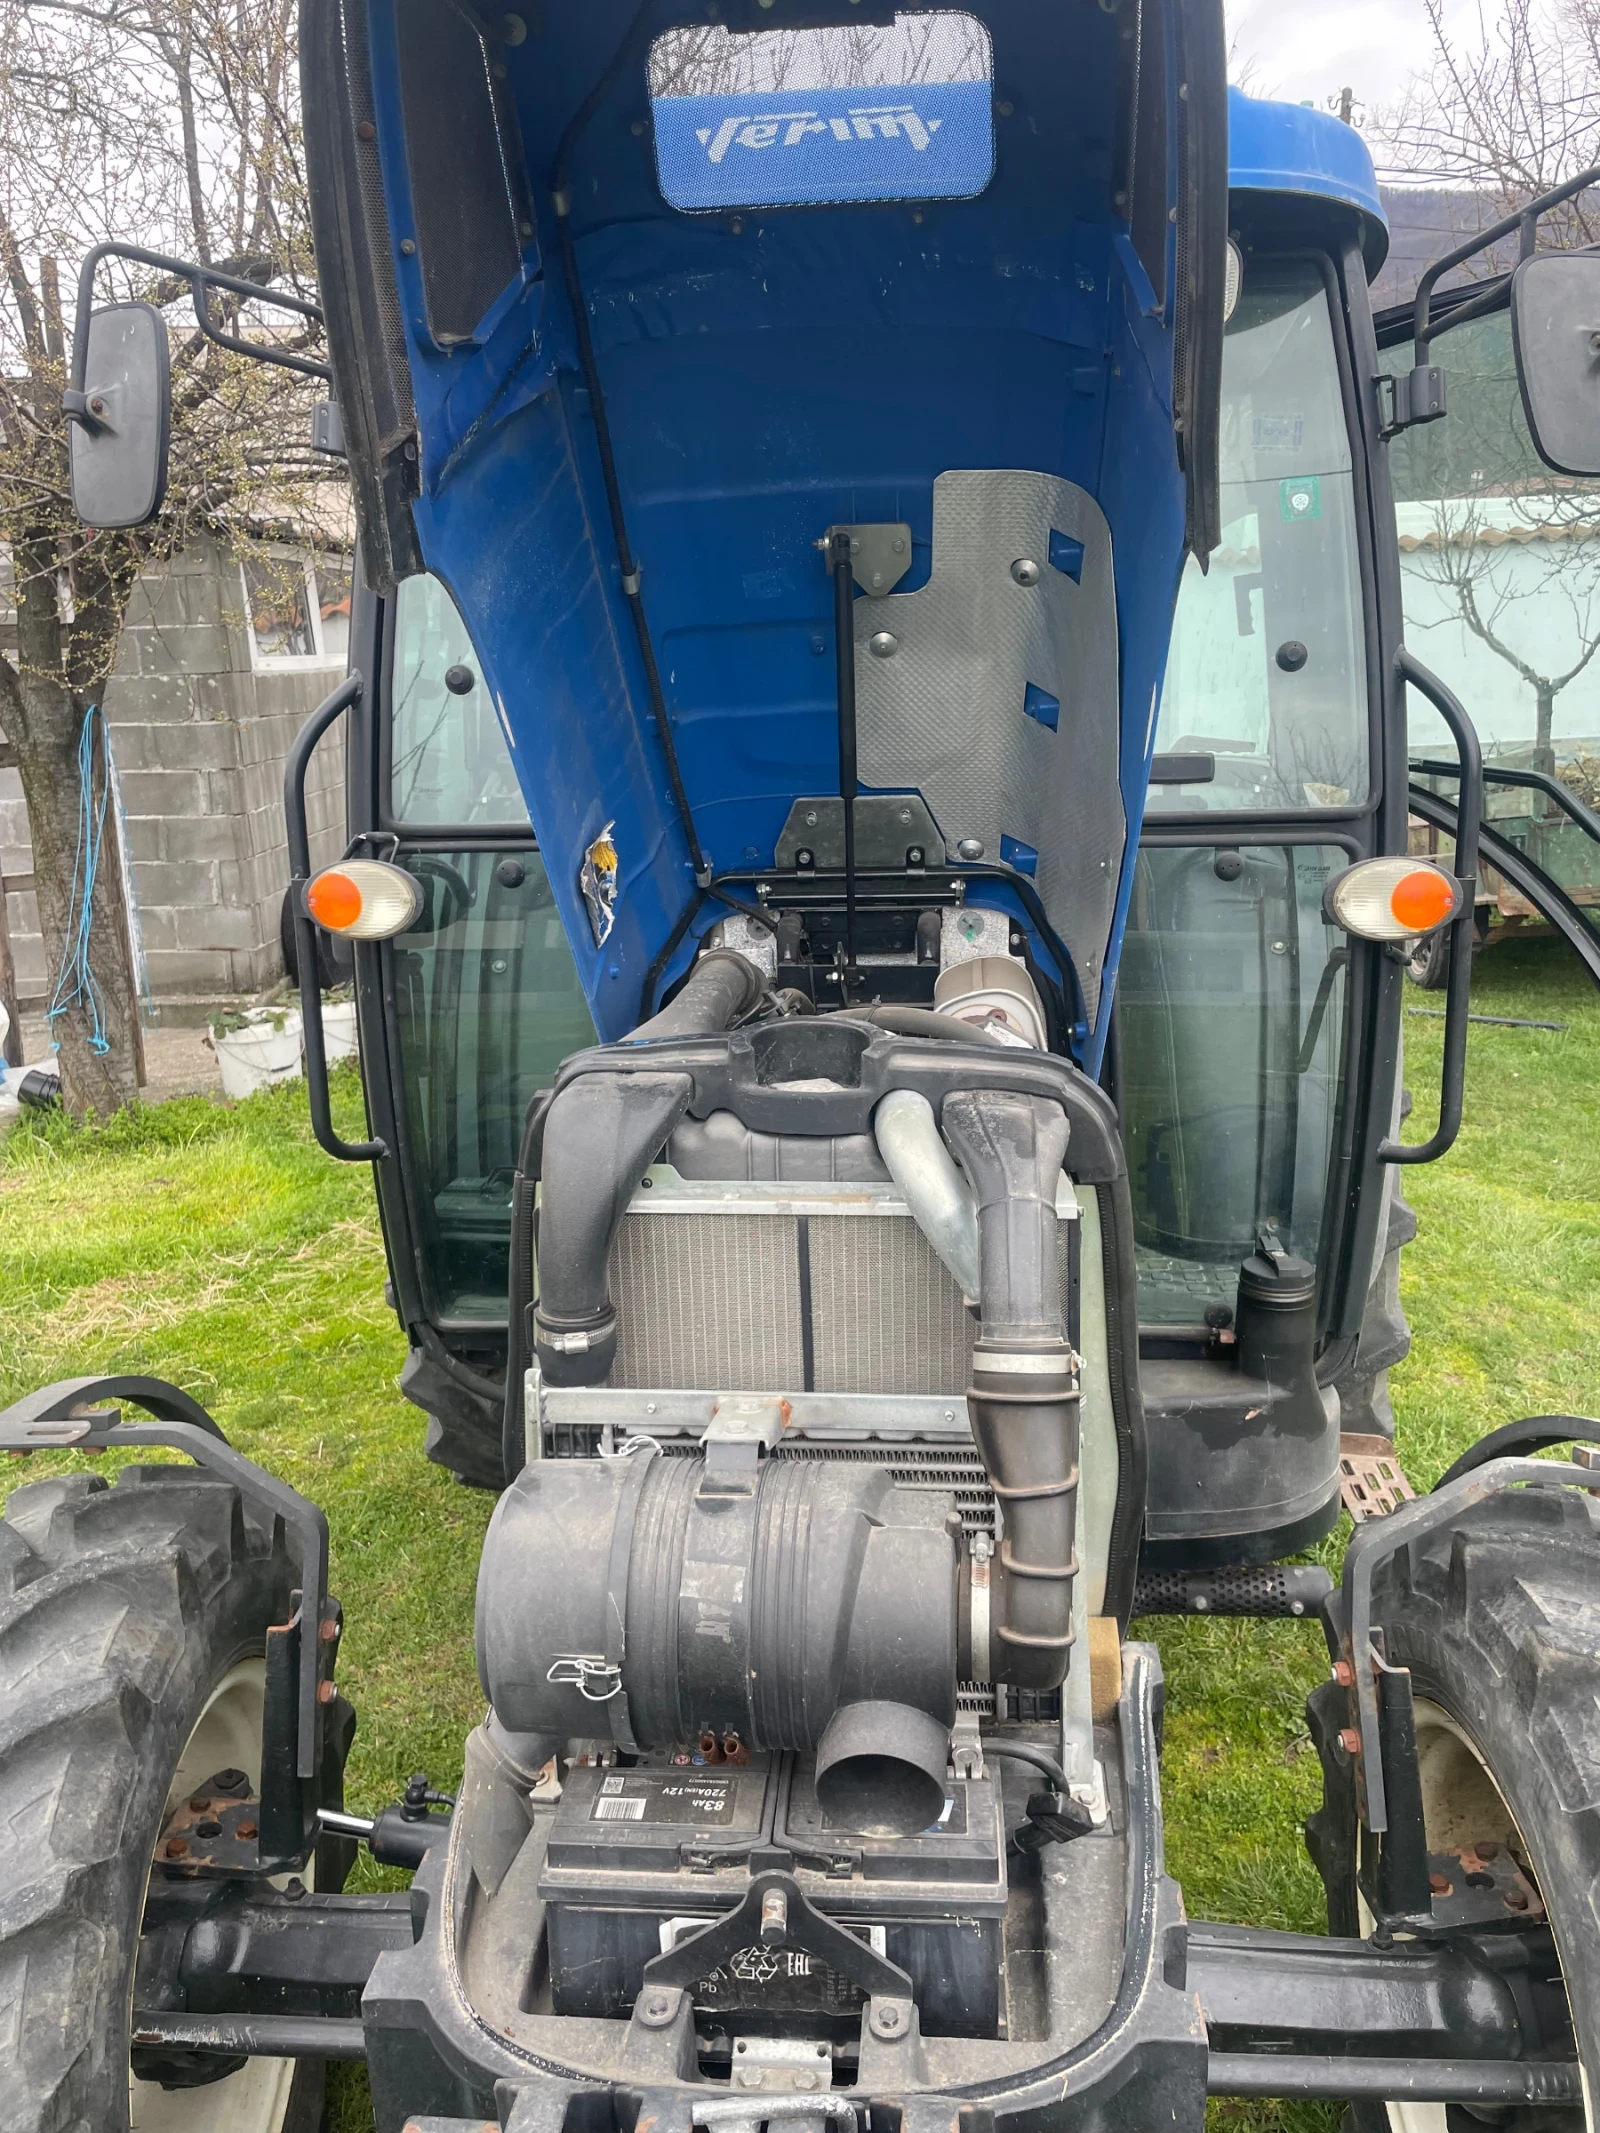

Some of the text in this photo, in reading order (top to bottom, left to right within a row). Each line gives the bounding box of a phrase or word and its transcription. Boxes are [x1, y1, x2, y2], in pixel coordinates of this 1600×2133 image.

[662, 1787, 684, 1796] 12V
[692, 1799, 725, 1811] 83Ah
[699, 1981, 717, 1993] Pb
